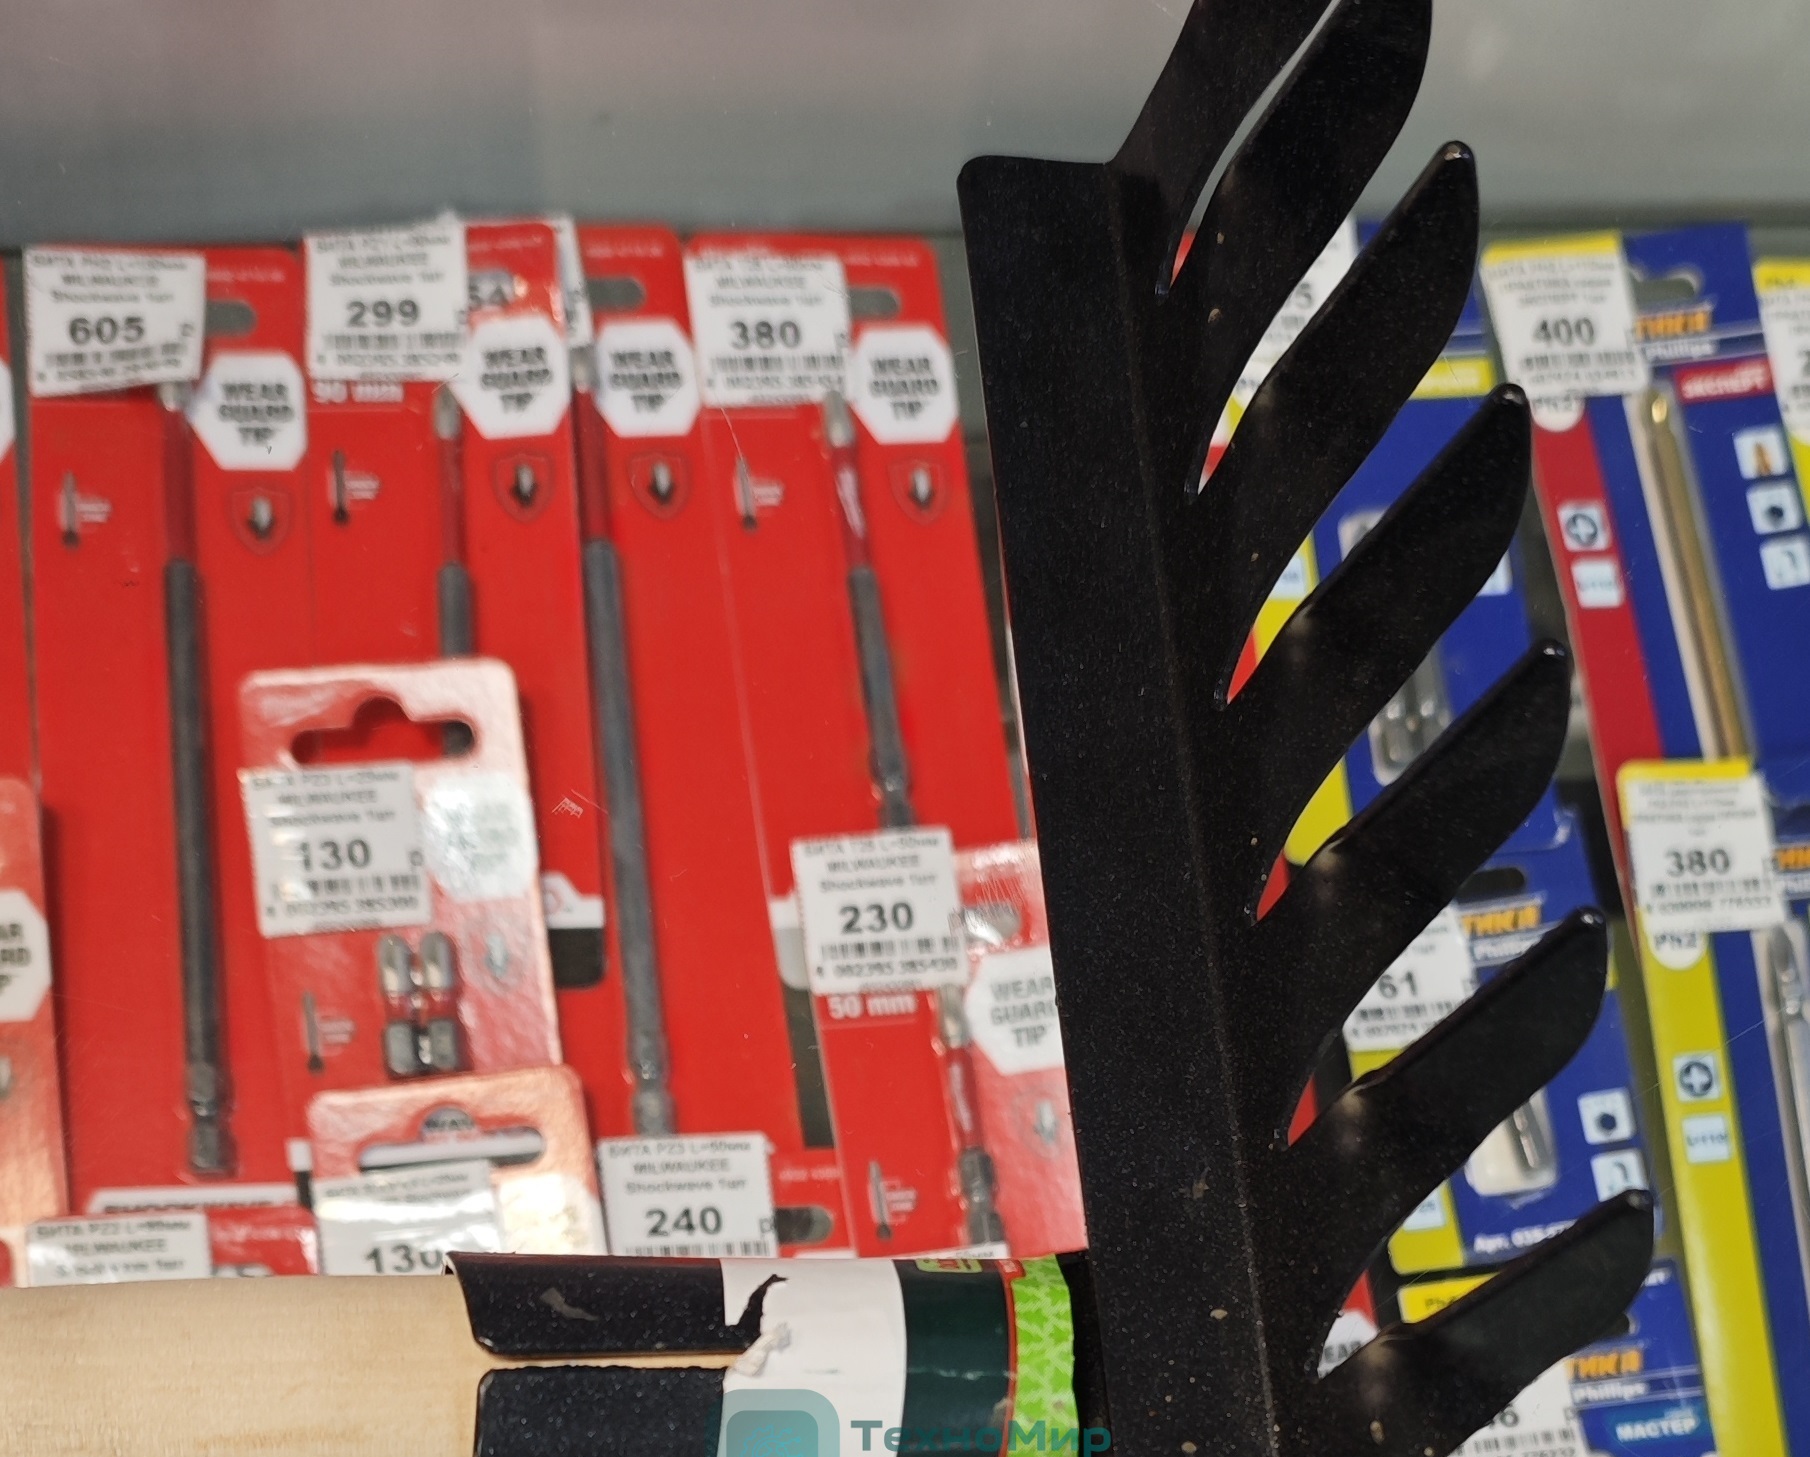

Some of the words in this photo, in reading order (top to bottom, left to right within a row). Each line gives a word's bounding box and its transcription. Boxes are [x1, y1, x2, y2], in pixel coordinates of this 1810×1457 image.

[347, 300, 419, 327] 299
[69, 316, 144, 345] 605
[730, 321, 801, 349] 380
[1533, 317, 1595, 347] 400
[298, 839, 372, 872] 130
[1665, 849, 1730, 877] 380
[839, 901, 914, 934] 230
[827, 995, 863, 1019] 50
[1011, 1025, 1046, 1048] TIP
[646, 1206, 723, 1237] 240
